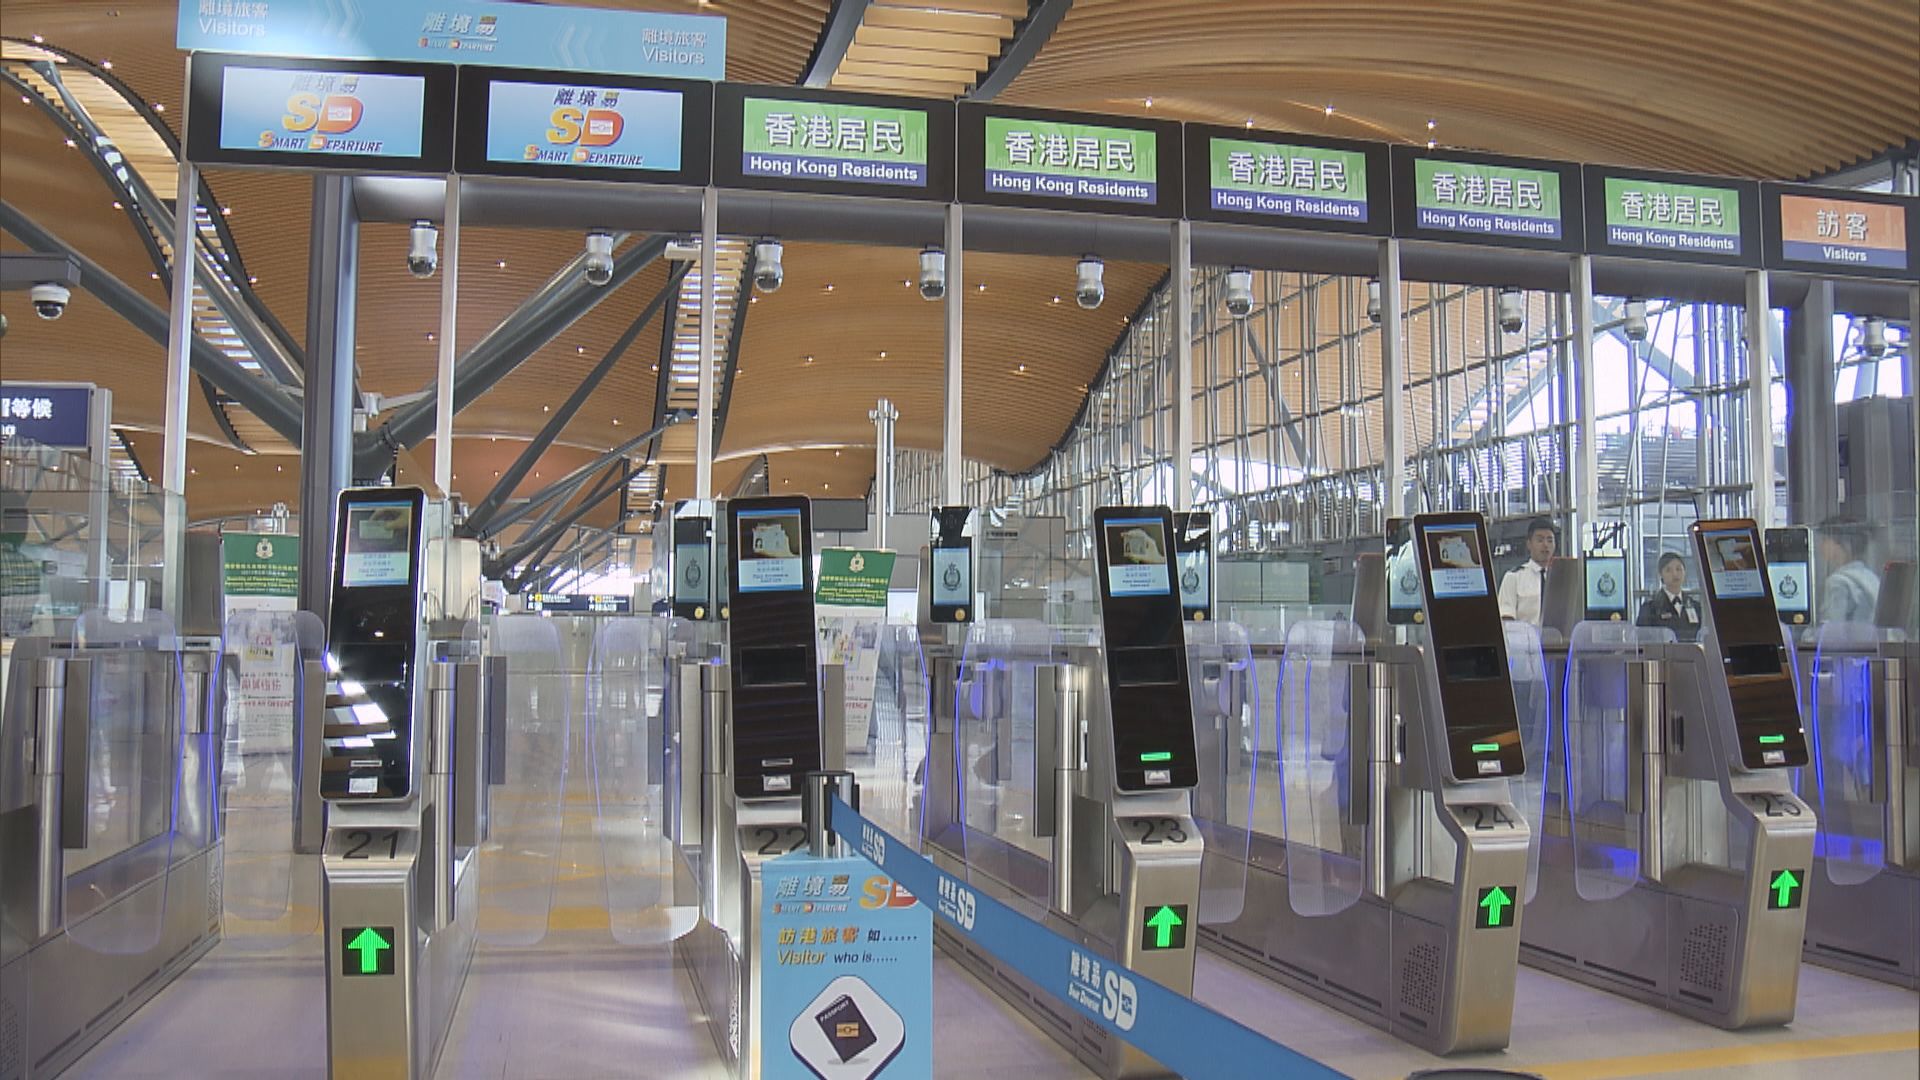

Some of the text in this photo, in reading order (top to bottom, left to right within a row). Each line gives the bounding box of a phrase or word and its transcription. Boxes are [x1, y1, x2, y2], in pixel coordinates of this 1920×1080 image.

[199, 18, 265, 37] Visitors
[422, 12, 497, 36] 離境易
[643, 47, 705, 66] Visitors
[553, 88, 620, 108] 離境易
[281, 92, 364, 135] SD
[545, 107, 625, 147] SD
[764, 112, 905, 155] 香港居民
[258, 130, 383, 153] SMART DEPARTURE
[1004, 130, 1136, 173] 香港居民
[523, 144, 643, 166] SMART DEPARTURE
[750, 155, 919, 182] Hong Kong Residents
[1227, 151, 1348, 192] 香港居民
[992, 173, 1150, 200] Hong Kong Residents
[1431, 171, 1544, 211] 香港居民
[1216, 192, 1361, 218] Hong Kong Residents
[1620, 189, 1724, 228] 香港居民
[1422, 210, 1556, 235] Hong Kong Residents
[1816, 209, 1869, 241] 訪客
[1612, 227, 1736, 251] Hong Kong Residents
[1822, 245, 1868, 263] Visitors
[1463, 806, 1515, 830] 24
[1751, 794, 1801, 817] 25
[1133, 818, 1188, 845] 23
[342, 830, 400, 860] 21
[776, 874, 850, 898] 離境易
[957, 887, 976, 931] SD
[778, 949, 827, 965] Visitor
[834, 951, 859, 964] who
[820, 1000, 849, 1024] PASSPORT
[1102, 969, 1138, 1032] SD
